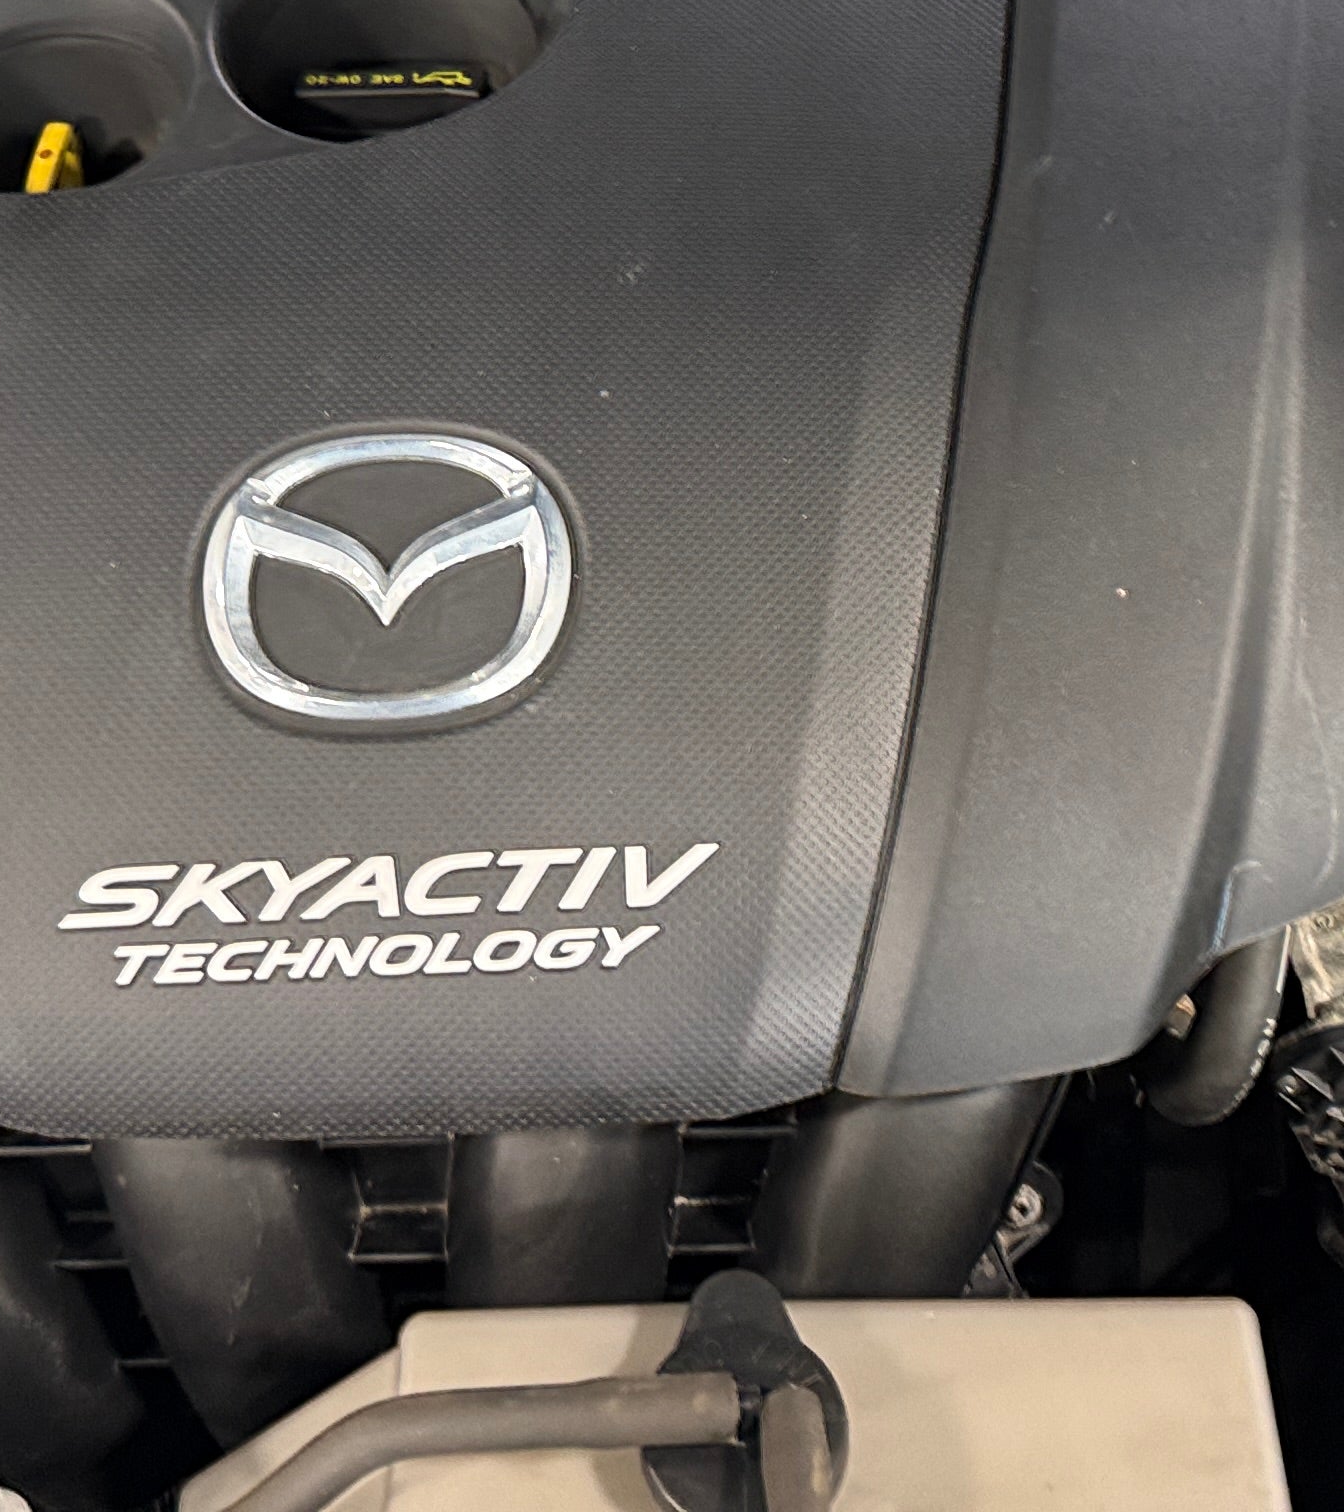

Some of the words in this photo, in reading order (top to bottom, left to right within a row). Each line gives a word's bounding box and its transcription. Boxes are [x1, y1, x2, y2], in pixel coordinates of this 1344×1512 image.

[370, 73, 405, 85] SAE
[57, 841, 721, 930] SKYACTIV
[112, 924, 662, 987] TECHNOLOGY
